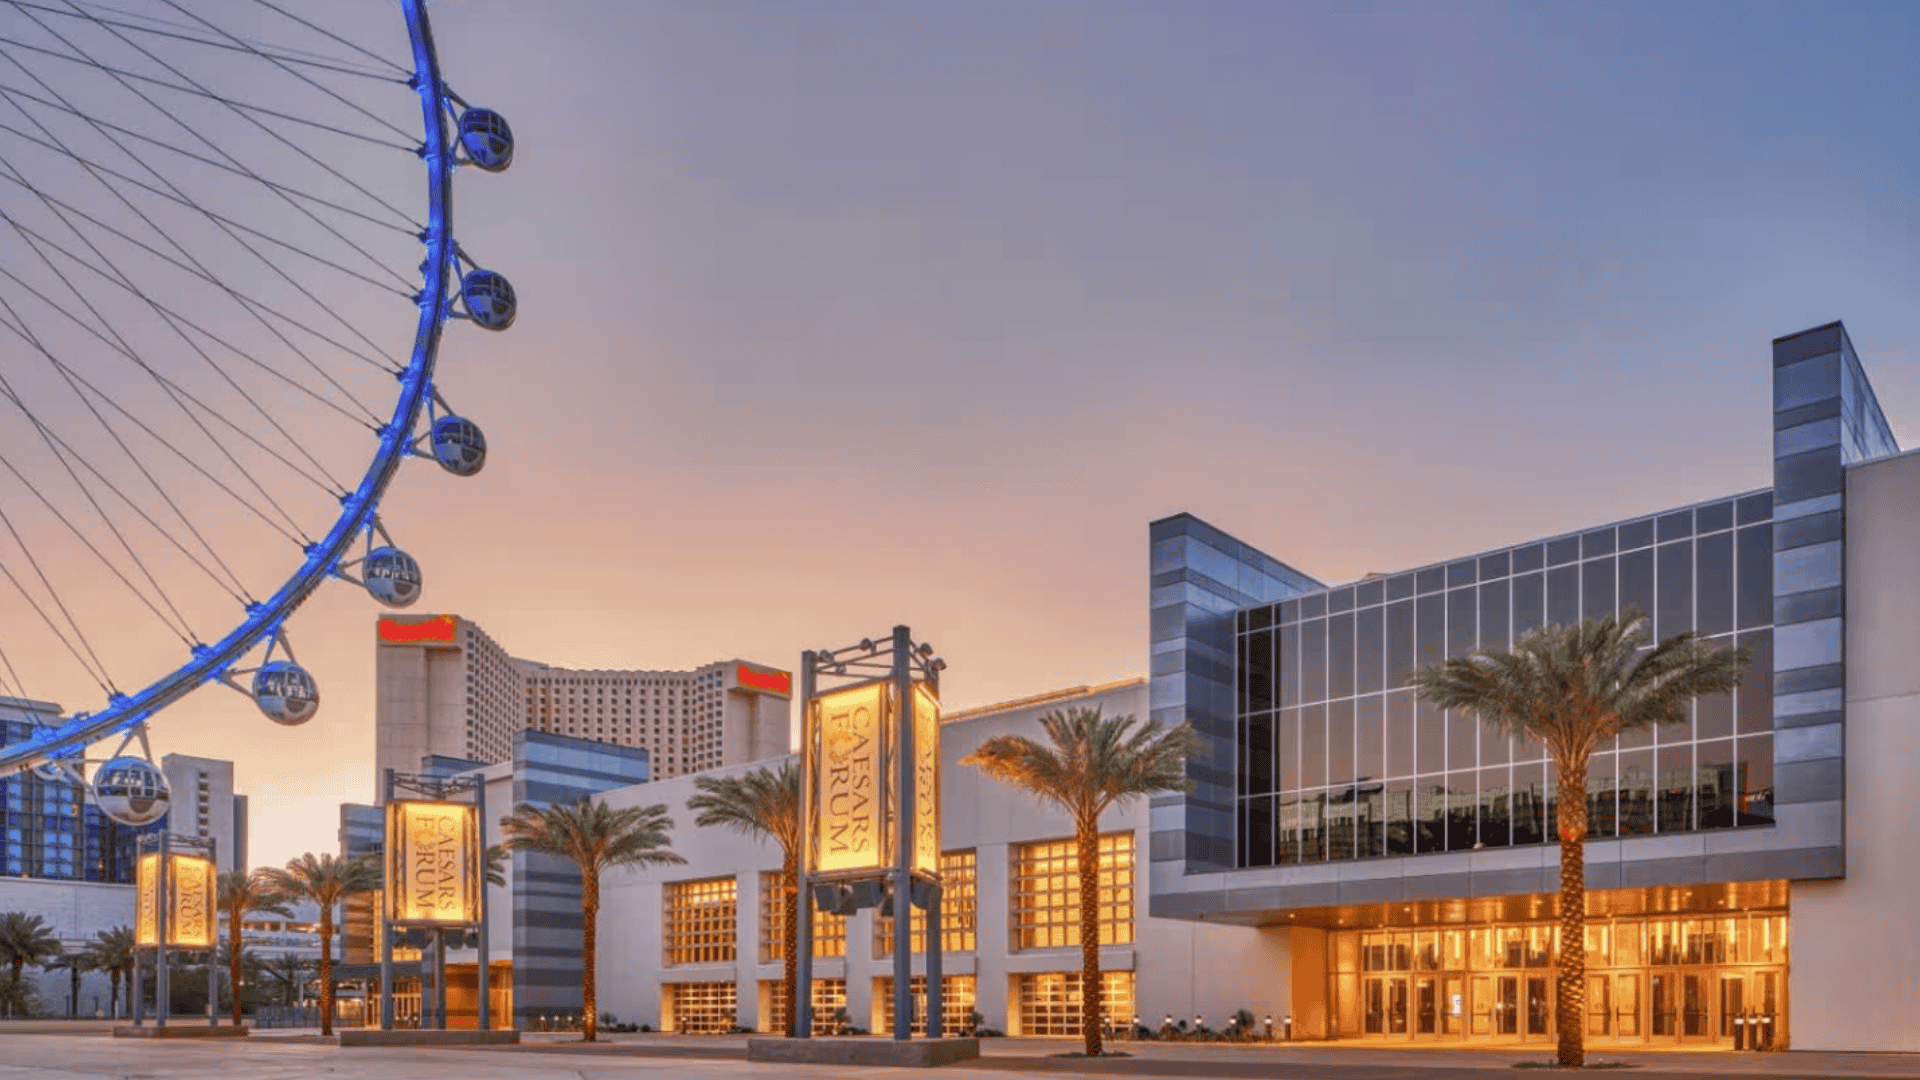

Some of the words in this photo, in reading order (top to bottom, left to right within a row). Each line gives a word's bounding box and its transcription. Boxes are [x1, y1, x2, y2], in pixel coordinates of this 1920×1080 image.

[829, 712, 852, 852] FORUM
[851, 706, 872, 853] CAESARS
[437, 816, 456, 911] CAESARS
